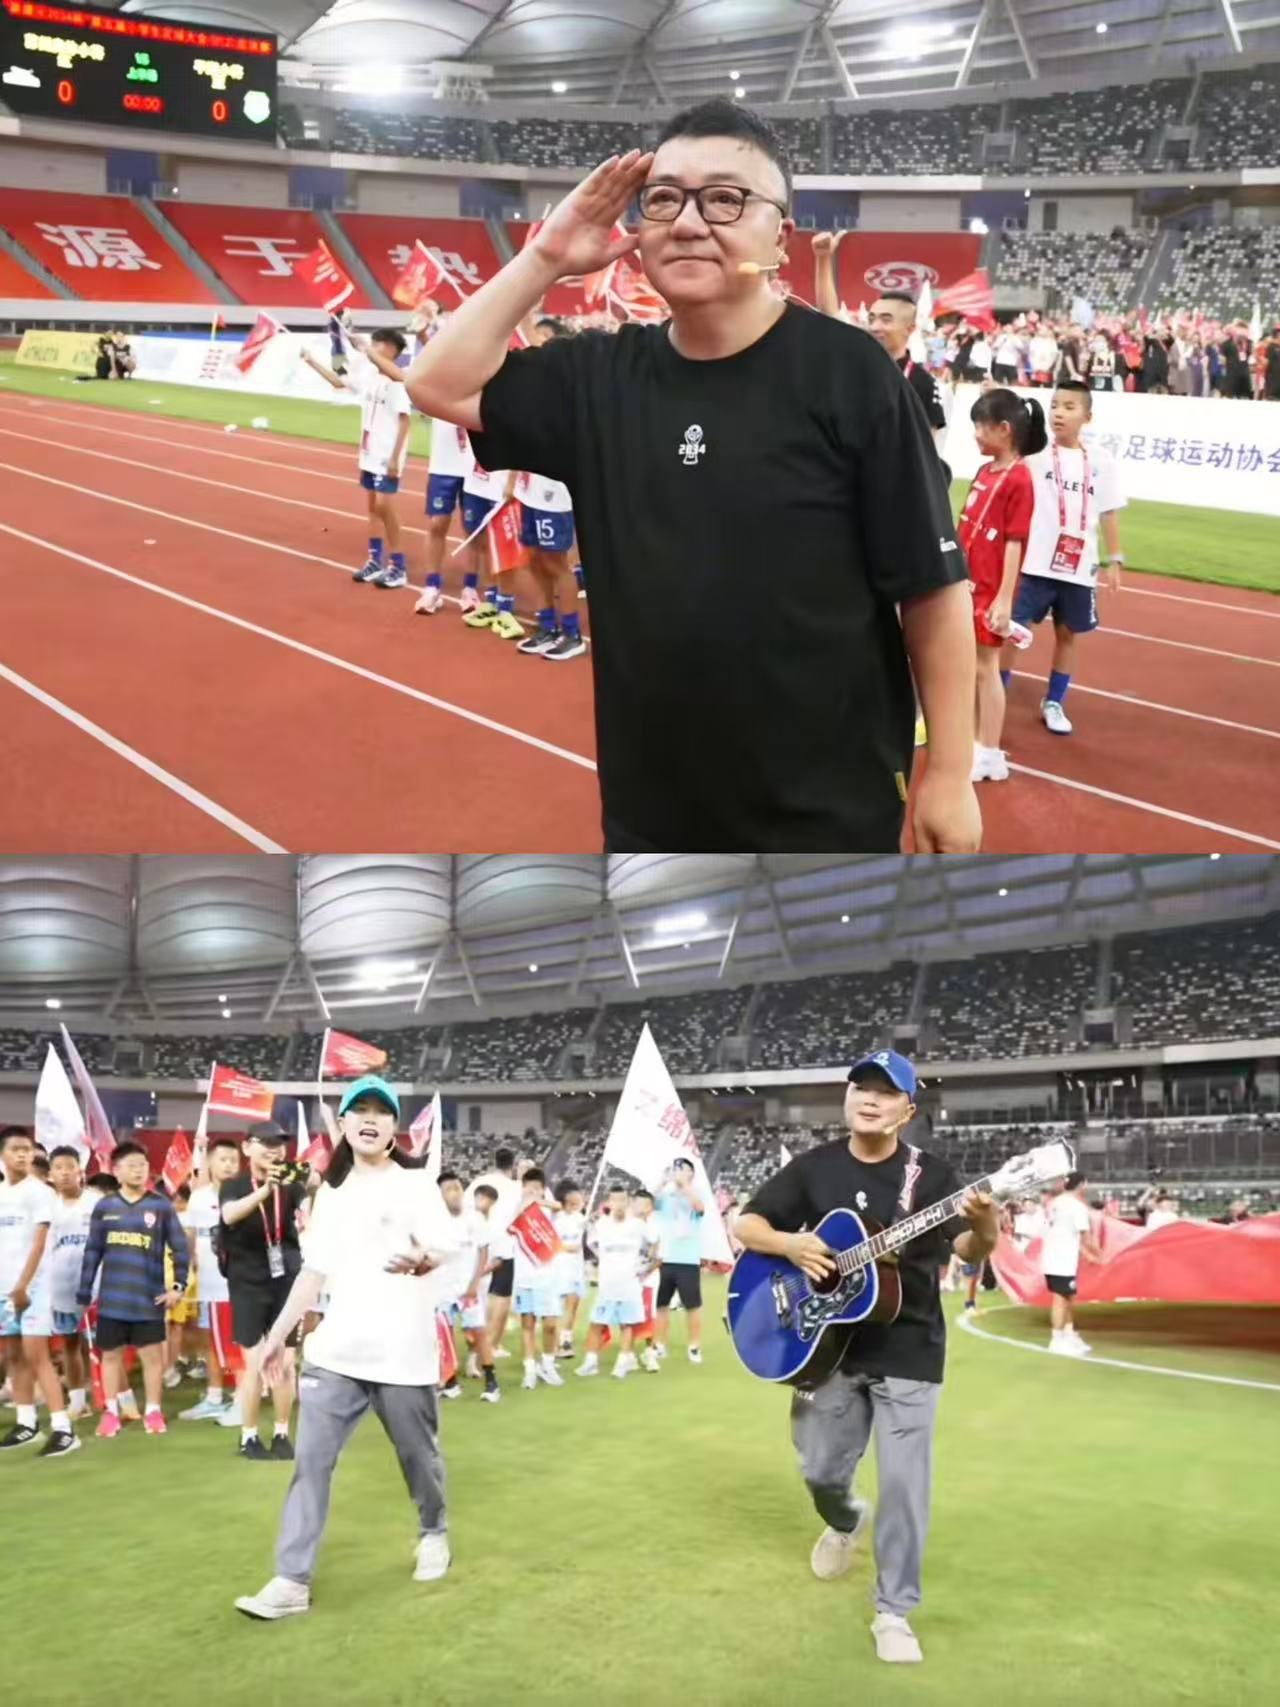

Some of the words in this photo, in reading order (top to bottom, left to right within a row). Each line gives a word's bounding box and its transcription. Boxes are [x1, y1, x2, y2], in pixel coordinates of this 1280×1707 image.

[57, 80, 73, 103] 0
[123, 94, 162, 111] 00:00
[212, 100, 227, 121] 0
[34, 221, 163, 270] 源
[535, 518, 555, 540] 15
